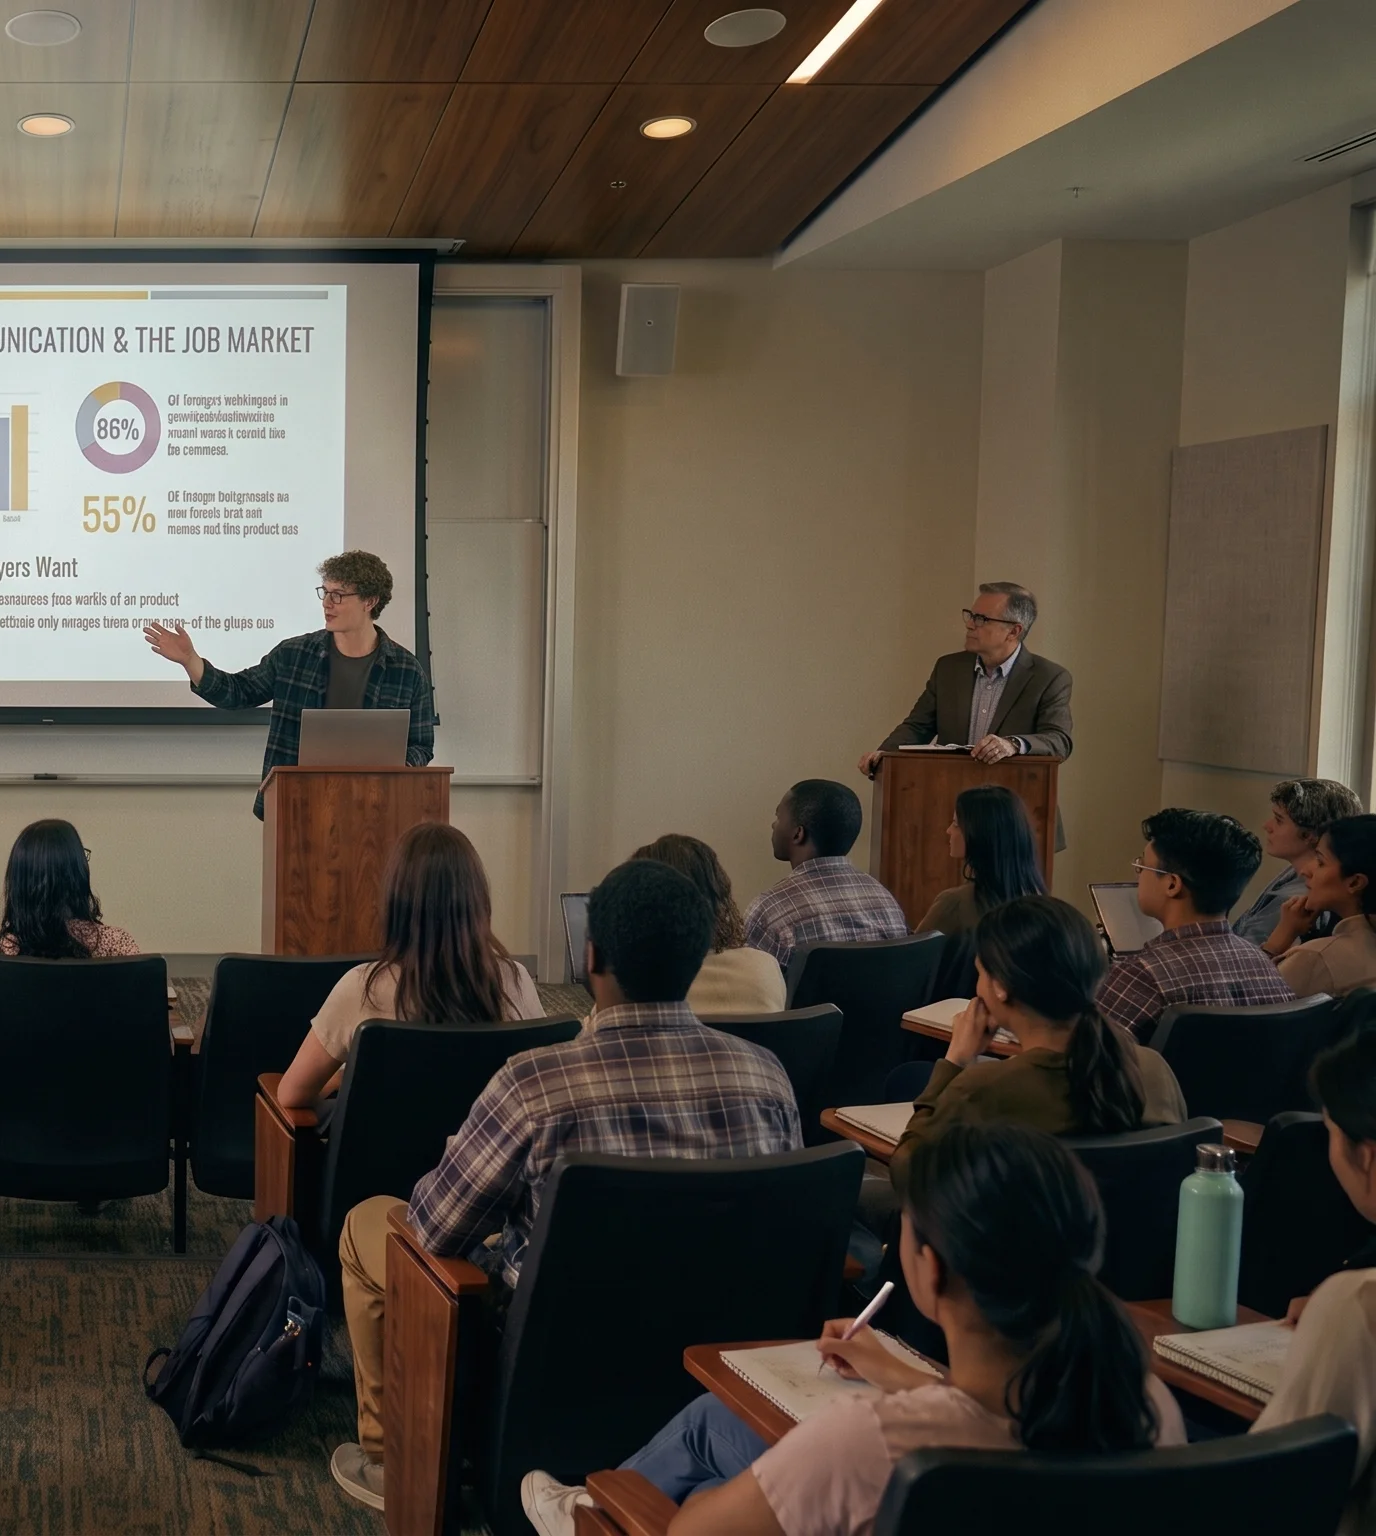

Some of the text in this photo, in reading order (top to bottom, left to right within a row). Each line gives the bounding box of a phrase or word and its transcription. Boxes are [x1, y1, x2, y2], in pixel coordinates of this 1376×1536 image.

[112, 326, 128, 353] &
[135, 326, 175, 353] THE
[182, 326, 220, 353] JOB
[228, 326, 315, 353] MARKET
[97, 418, 139, 440] 86%
[82, 496, 156, 533] 55%
[243, 522, 279, 538] product
[36, 556, 78, 578] Want
[110, 592, 121, 606] of
[124, 595, 136, 606] an
[140, 592, 180, 608] product
[37, 615, 59, 631] only
[205, 616, 221, 629] the
